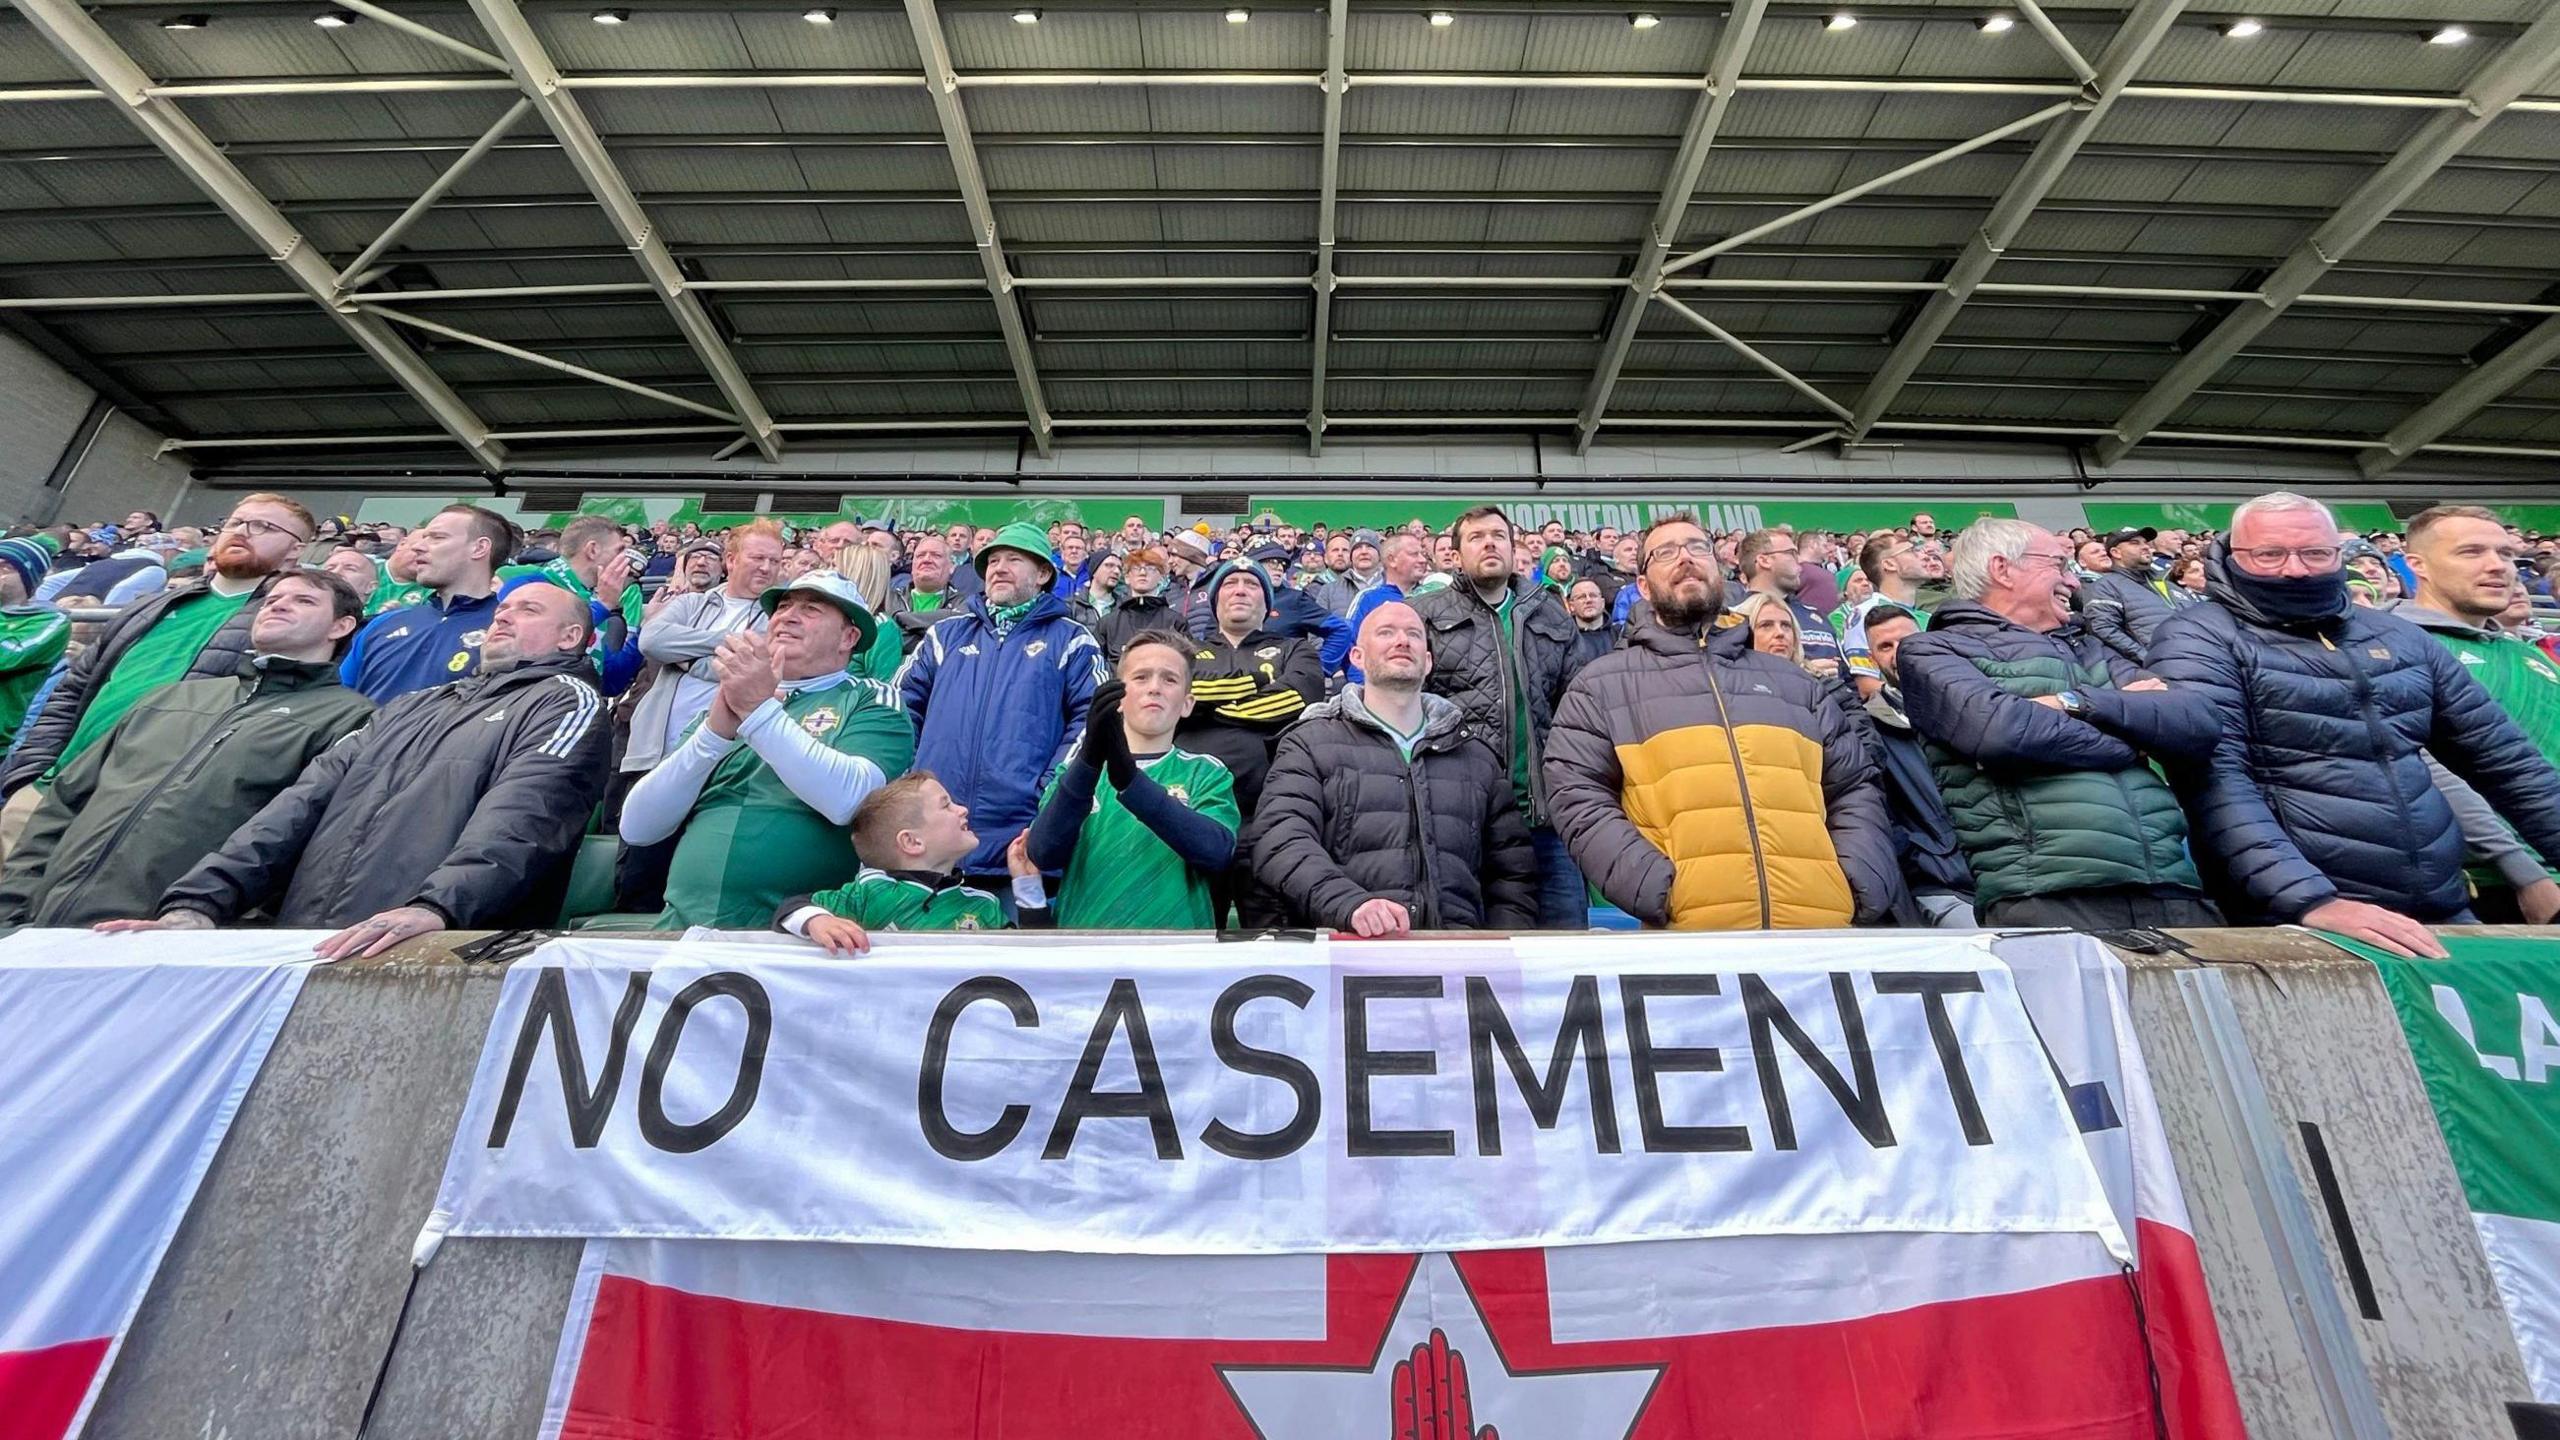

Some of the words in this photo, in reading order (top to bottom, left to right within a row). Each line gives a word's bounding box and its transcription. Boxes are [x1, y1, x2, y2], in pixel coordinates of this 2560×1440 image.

[1648, 504, 1764, 536] IAND
[487, 967, 772, 1154] NO
[918, 971, 1994, 1160] CASEMENT
